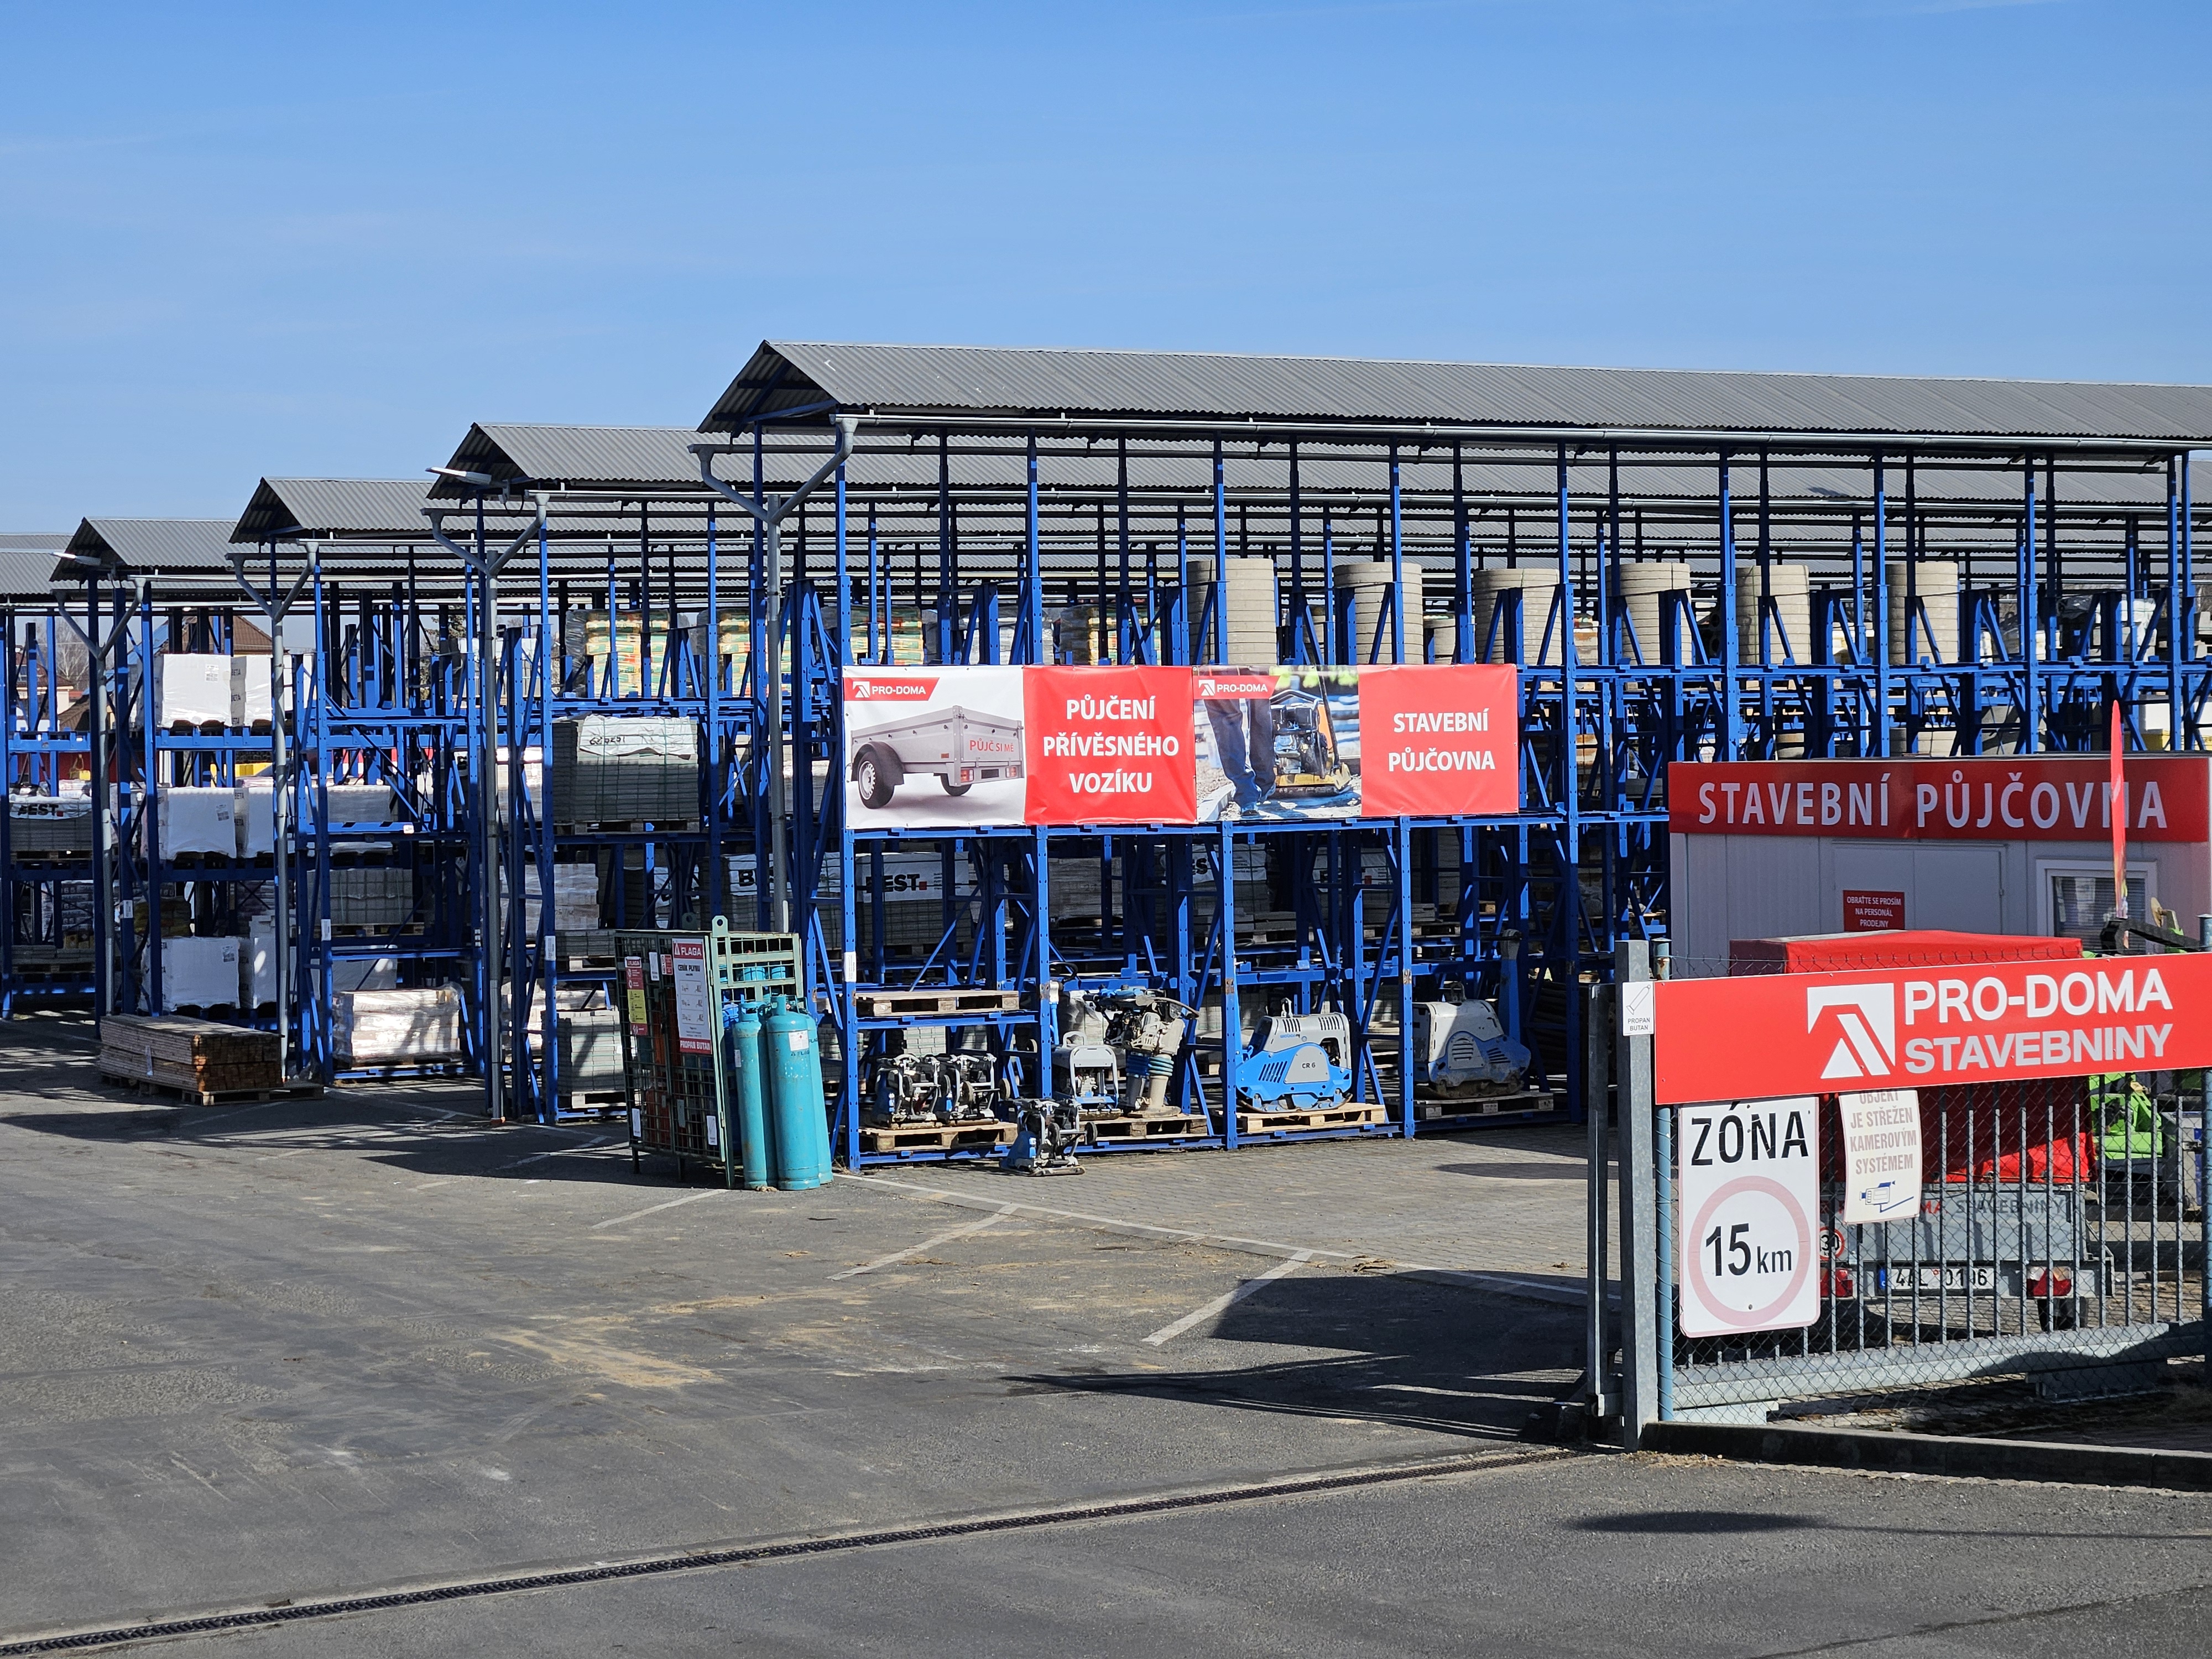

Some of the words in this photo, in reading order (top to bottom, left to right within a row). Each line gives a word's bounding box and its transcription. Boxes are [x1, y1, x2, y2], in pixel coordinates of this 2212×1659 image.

[872, 686, 926, 695] PRO-DOMA
[1217, 684, 1268, 692] PRO-DOMA
[1067, 693, 1156, 719] PŮJČENÍ
[1394, 708, 1489, 733] STAVEBNÍ
[969, 738, 994, 752] PŮJČ
[996, 743, 1003, 752] SI
[1004, 742, 1014, 752] MĚ
[1043, 732, 1179, 757] PŘÍVĚSNÉHO
[1388, 747, 1495, 771] PŮJČOVNA
[1068, 768, 1152, 793] VOZÍKU
[1698, 774, 1890, 826] STAVEBNÍ
[1847, 895, 1871, 904] OBRAŤTE
[1880, 896, 1901, 905] PROSÍM
[1864, 907, 1893, 916] PERSONÁL
[1860, 919, 1888, 927] PRODEJNY
[681, 947, 702, 956] FLAGA
[1905, 968, 2173, 1025] PRO-DOMA
[1905, 1023, 2173, 1073] STAVEBNINY
[1859, 1092, 1898, 1105] OBJEKT
[1850, 1112, 1863, 1129] JE
[1866, 1105, 1913, 1127] STŘEŽEN
[1691, 1101, 1809, 1166] ZÓNA
[1850, 1128, 1917, 1152] KAMEROVÝM
[1855, 1152, 1913, 1175] SYSTÉMEM
[1705, 1223, 1751, 1276] 15
[1756, 1246, 1792, 1274] km
